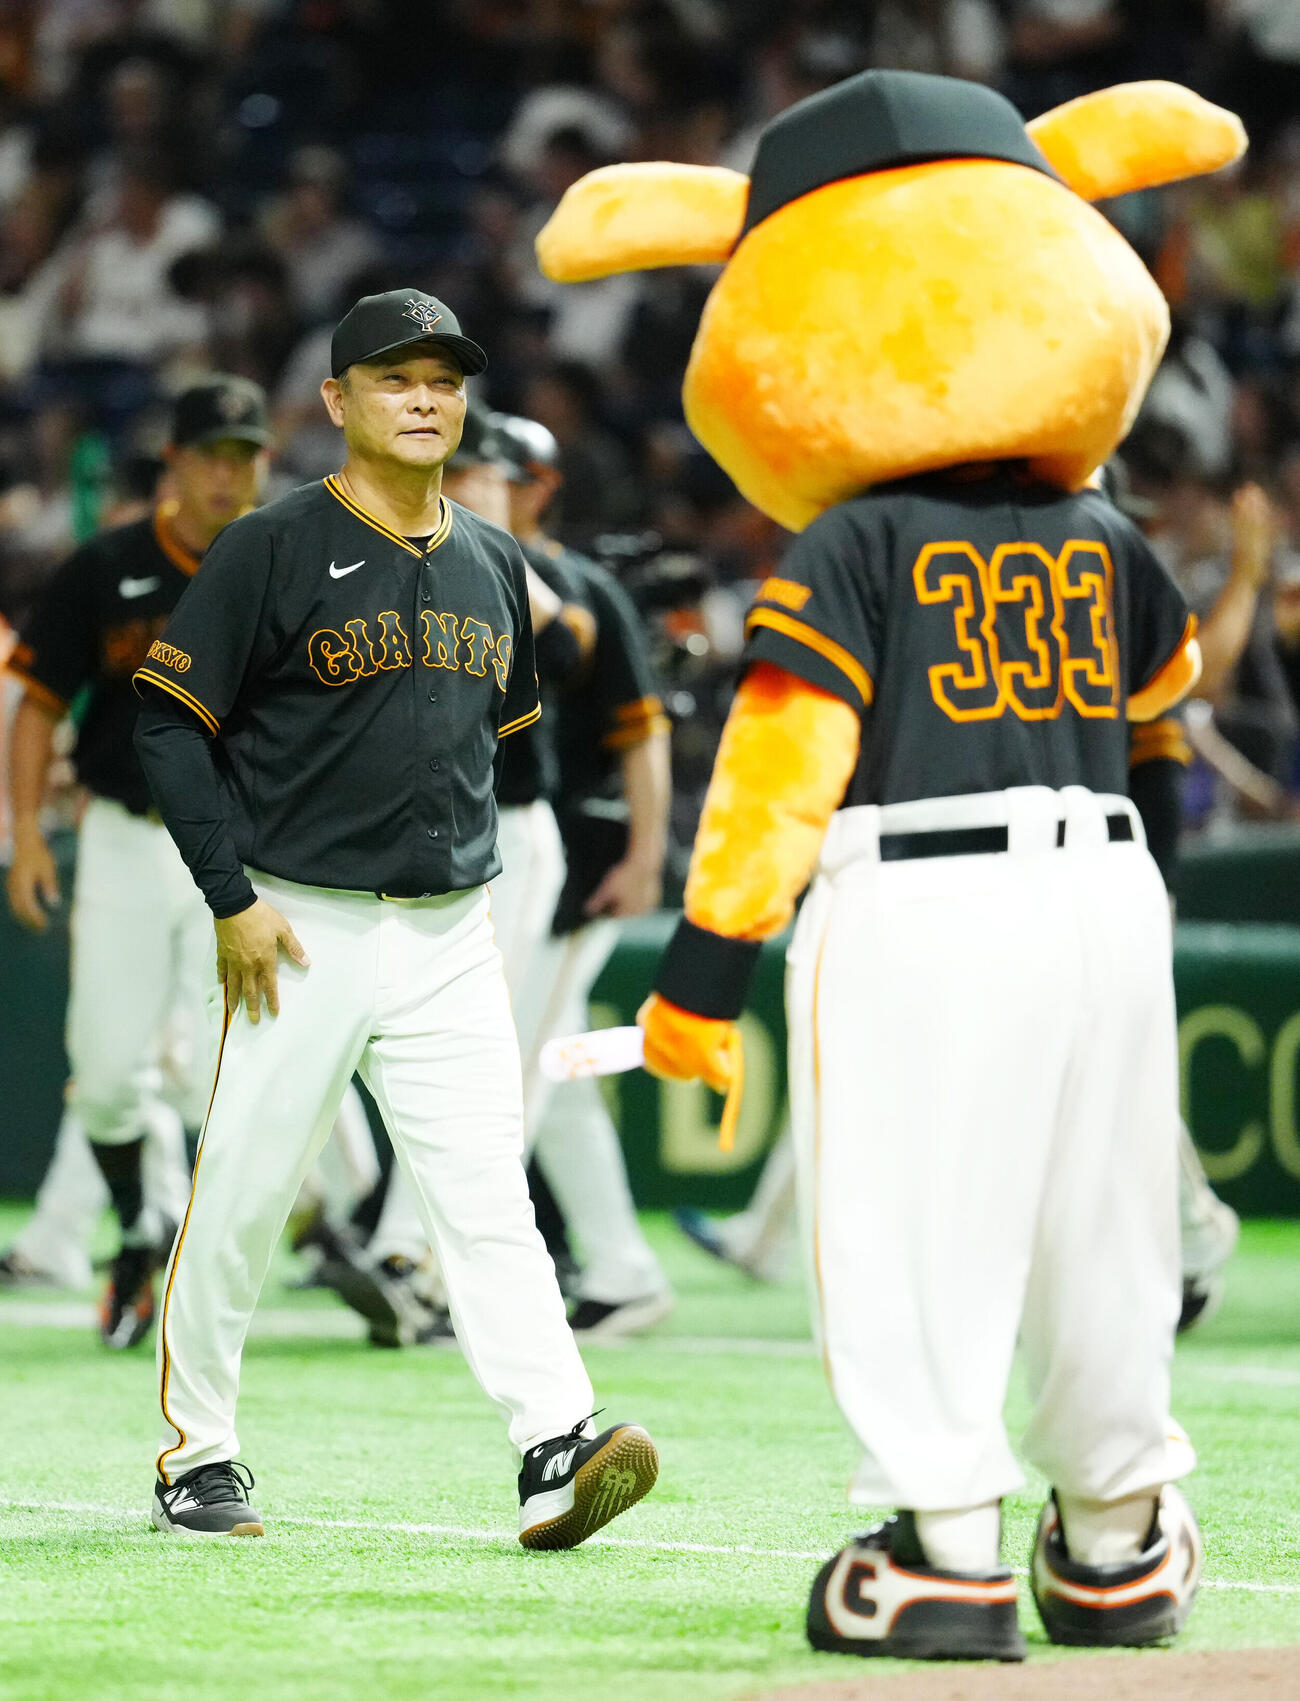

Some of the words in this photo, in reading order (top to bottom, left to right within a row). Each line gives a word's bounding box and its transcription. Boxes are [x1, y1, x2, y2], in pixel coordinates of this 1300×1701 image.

[146, 640, 192, 673] OKYO
[309, 609, 512, 693] GIANTS
[912, 539, 1120, 723] 333
